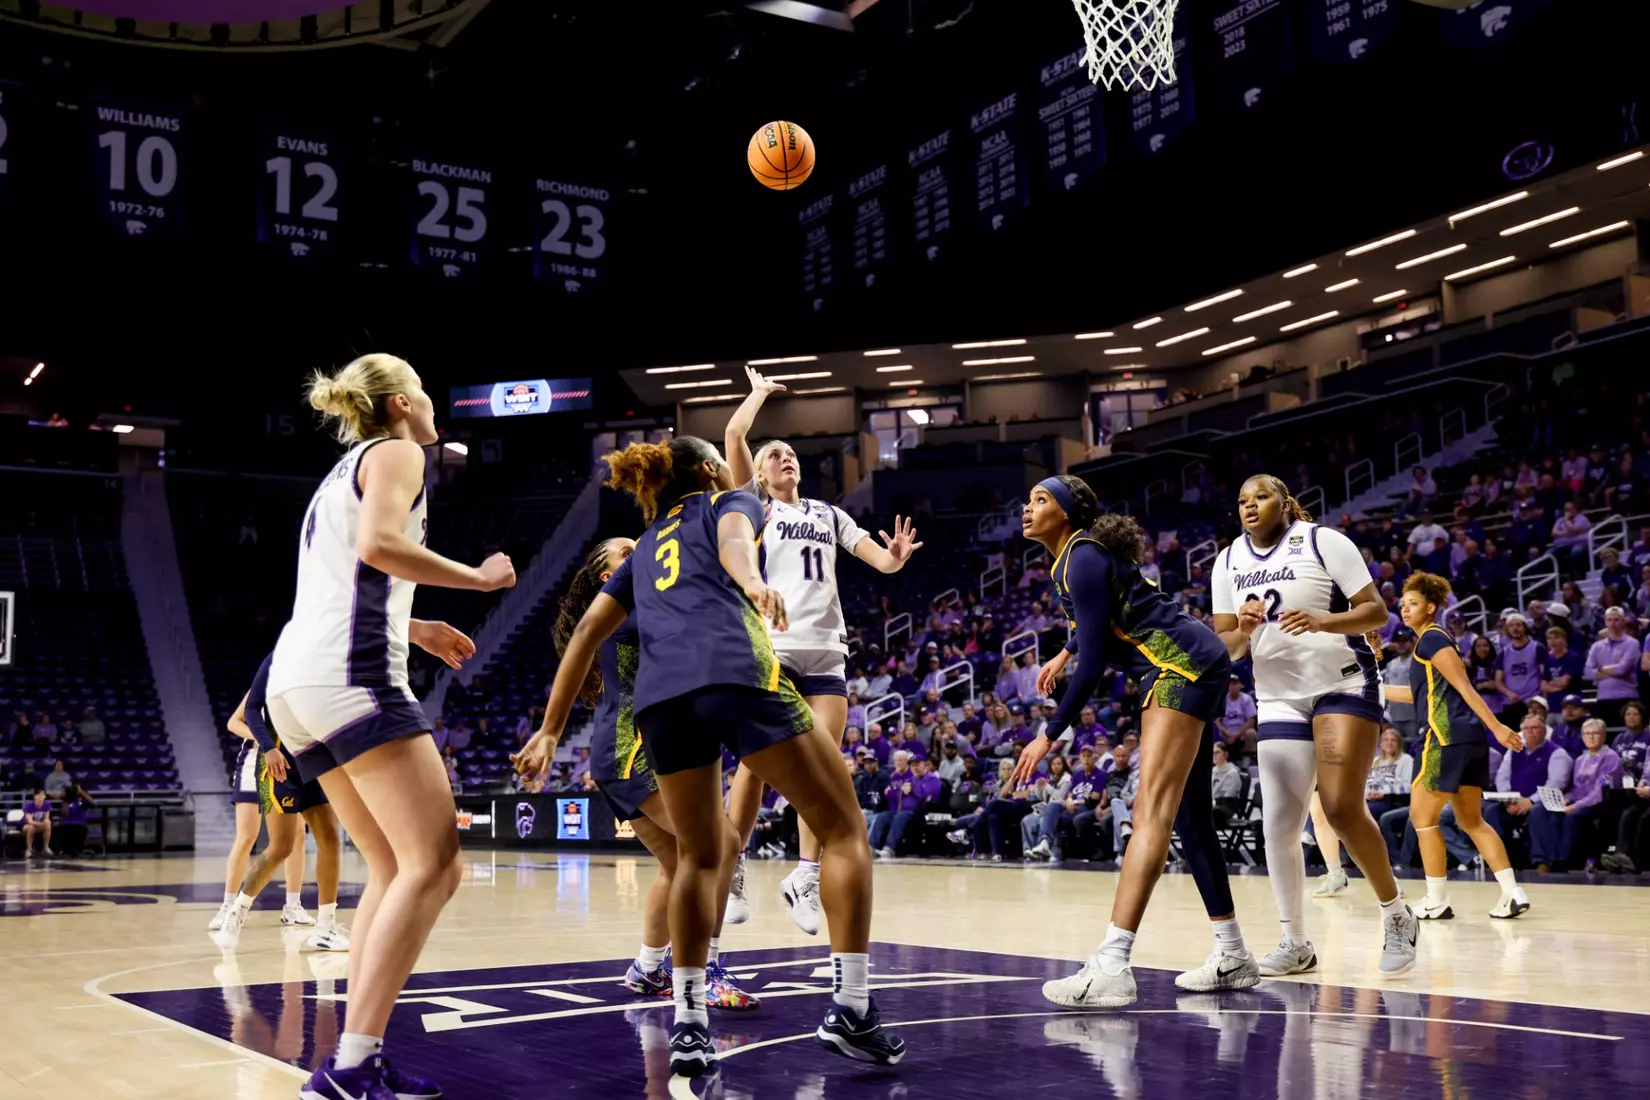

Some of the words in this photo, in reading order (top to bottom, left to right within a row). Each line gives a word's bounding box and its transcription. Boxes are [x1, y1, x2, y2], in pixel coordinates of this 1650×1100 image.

[97, 106, 181, 132] WILLIAMS
[970, 92, 1018, 130] K-STATE
[276, 136, 329, 156] EVANS
[907, 129, 951, 165] K-STATE
[97, 130, 178, 197] 10
[412, 158, 492, 184] BLACKMAN
[265, 156, 339, 221] 12
[535, 178, 610, 202] RICHMOND
[108, 200, 166, 219] 1972-76
[416, 180, 488, 243] 25
[273, 223, 329, 242] 1974-78
[540, 199, 606, 260] 23
[428, 246, 477, 263] 1977-81
[263, 411, 297, 438] 15
[655, 537, 681, 592] 3
[800, 545, 825, 582] 11
[1233, 566, 1297, 591] Wildcats
